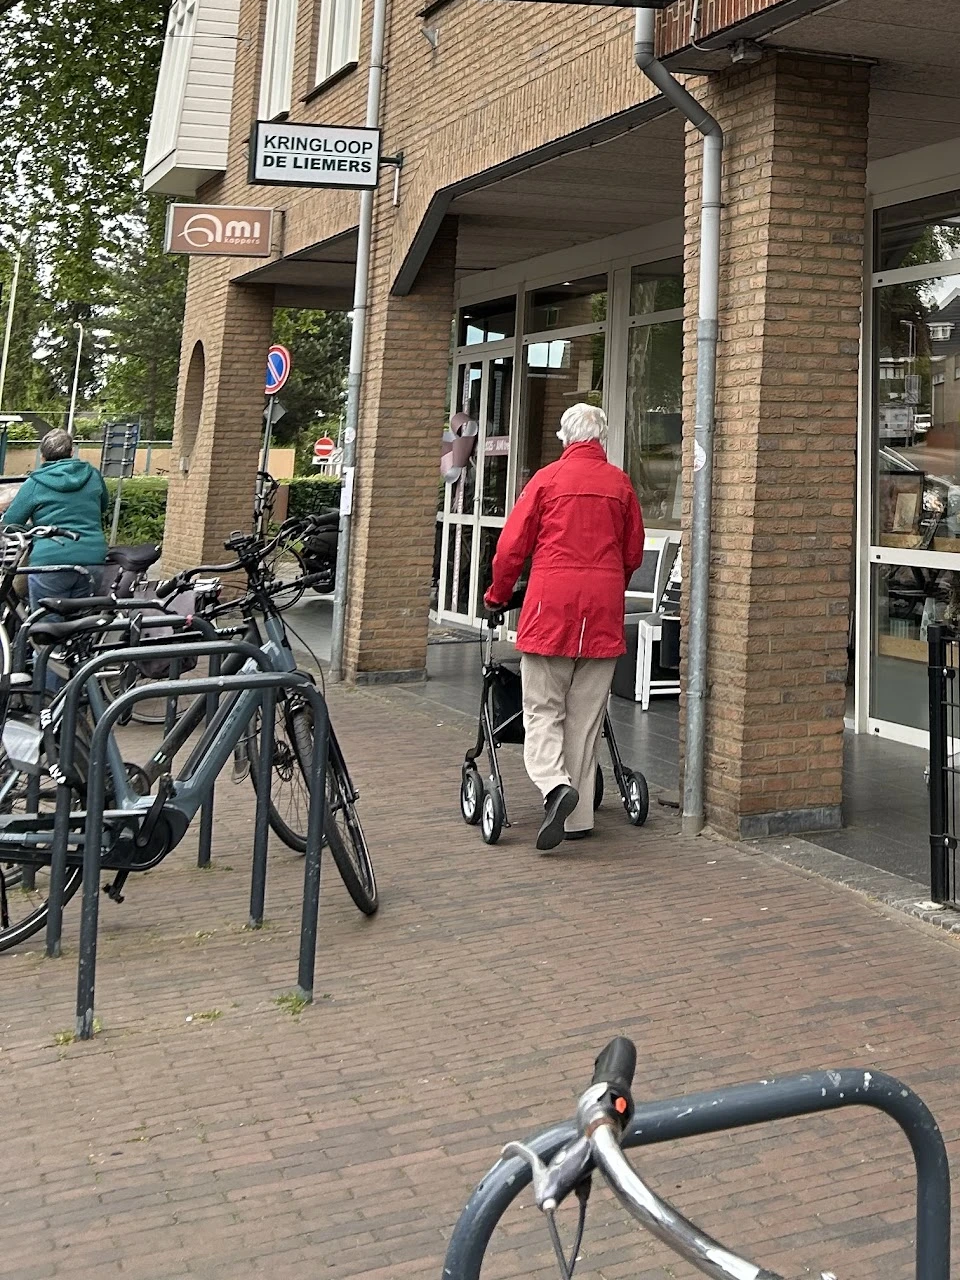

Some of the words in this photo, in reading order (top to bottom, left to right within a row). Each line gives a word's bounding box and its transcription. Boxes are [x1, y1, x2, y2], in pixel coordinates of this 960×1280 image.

[264, 135, 373, 154] KRINGLOOP
[263, 155, 287, 168] DE
[293, 157, 371, 173] LIEMERS
[223, 236, 260, 245] kappers
